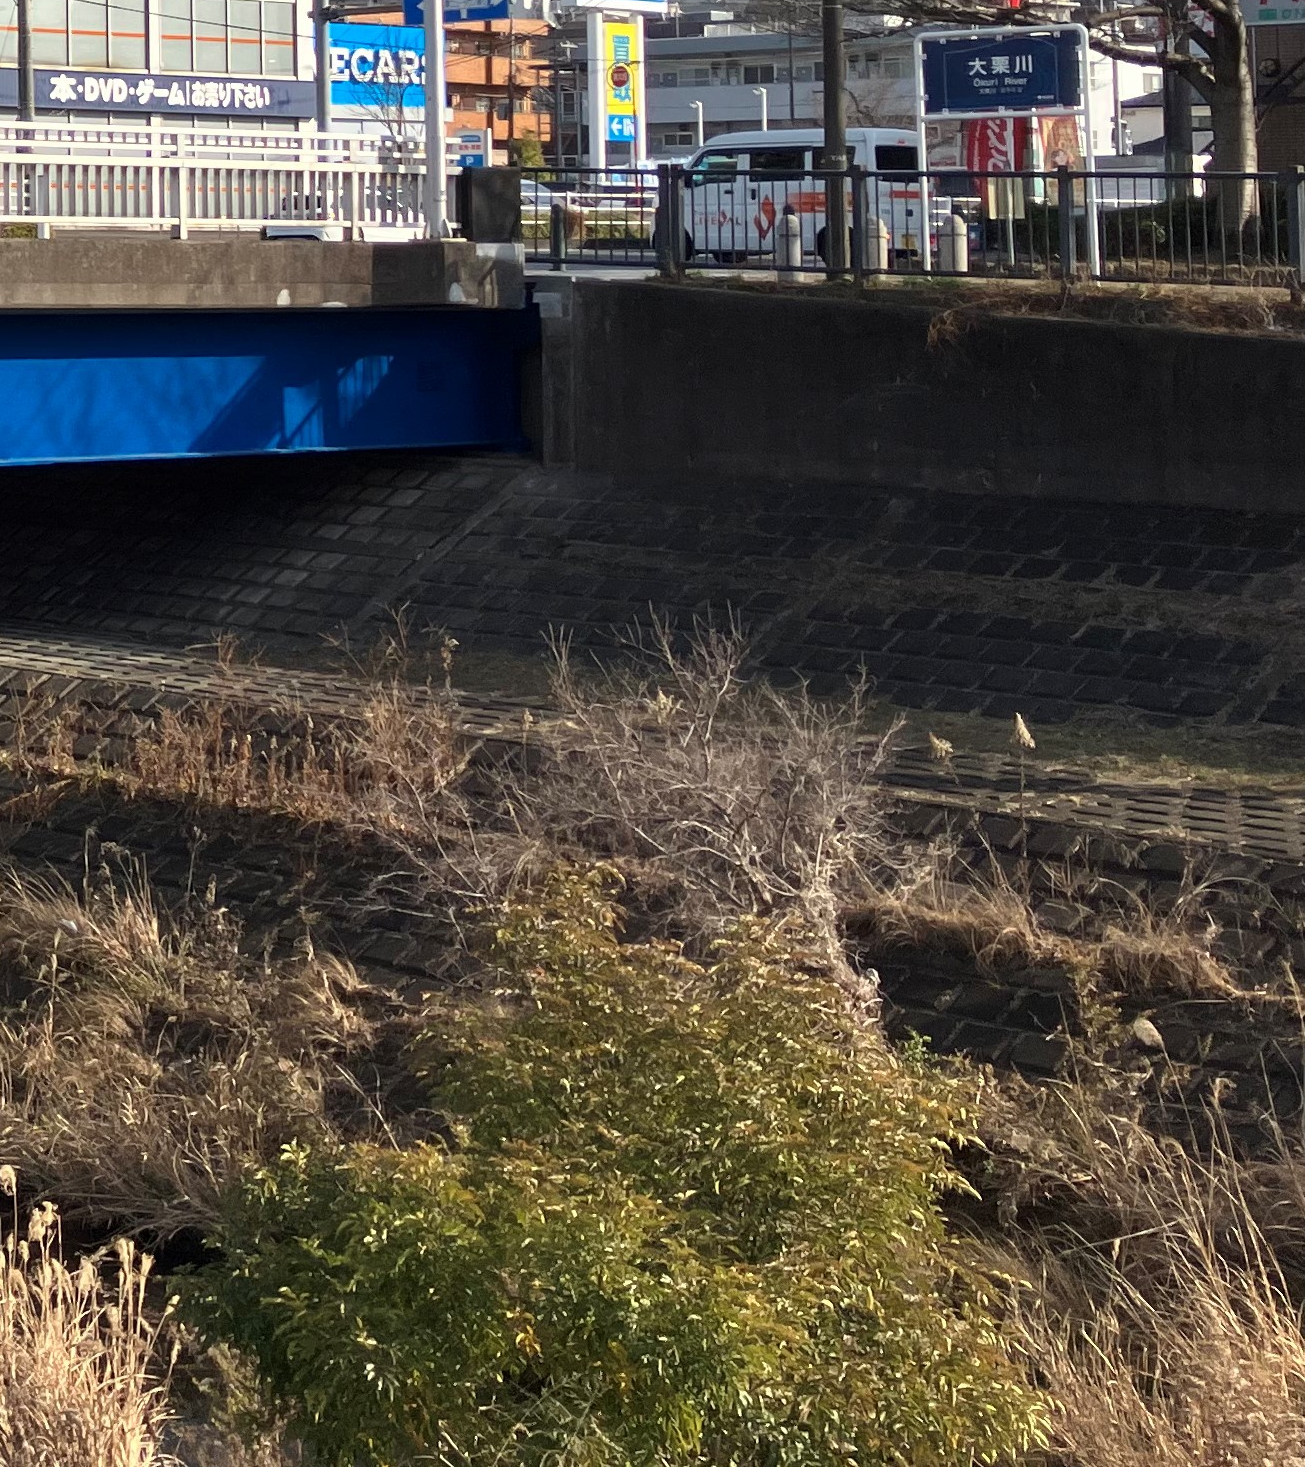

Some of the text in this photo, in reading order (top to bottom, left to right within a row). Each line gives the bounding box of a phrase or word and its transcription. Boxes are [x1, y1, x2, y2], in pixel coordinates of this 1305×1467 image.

[329, 47, 425, 84] ECAR
[968, 54, 1033, 76] 大栗川
[192, 81, 270, 108] お売り下さい
